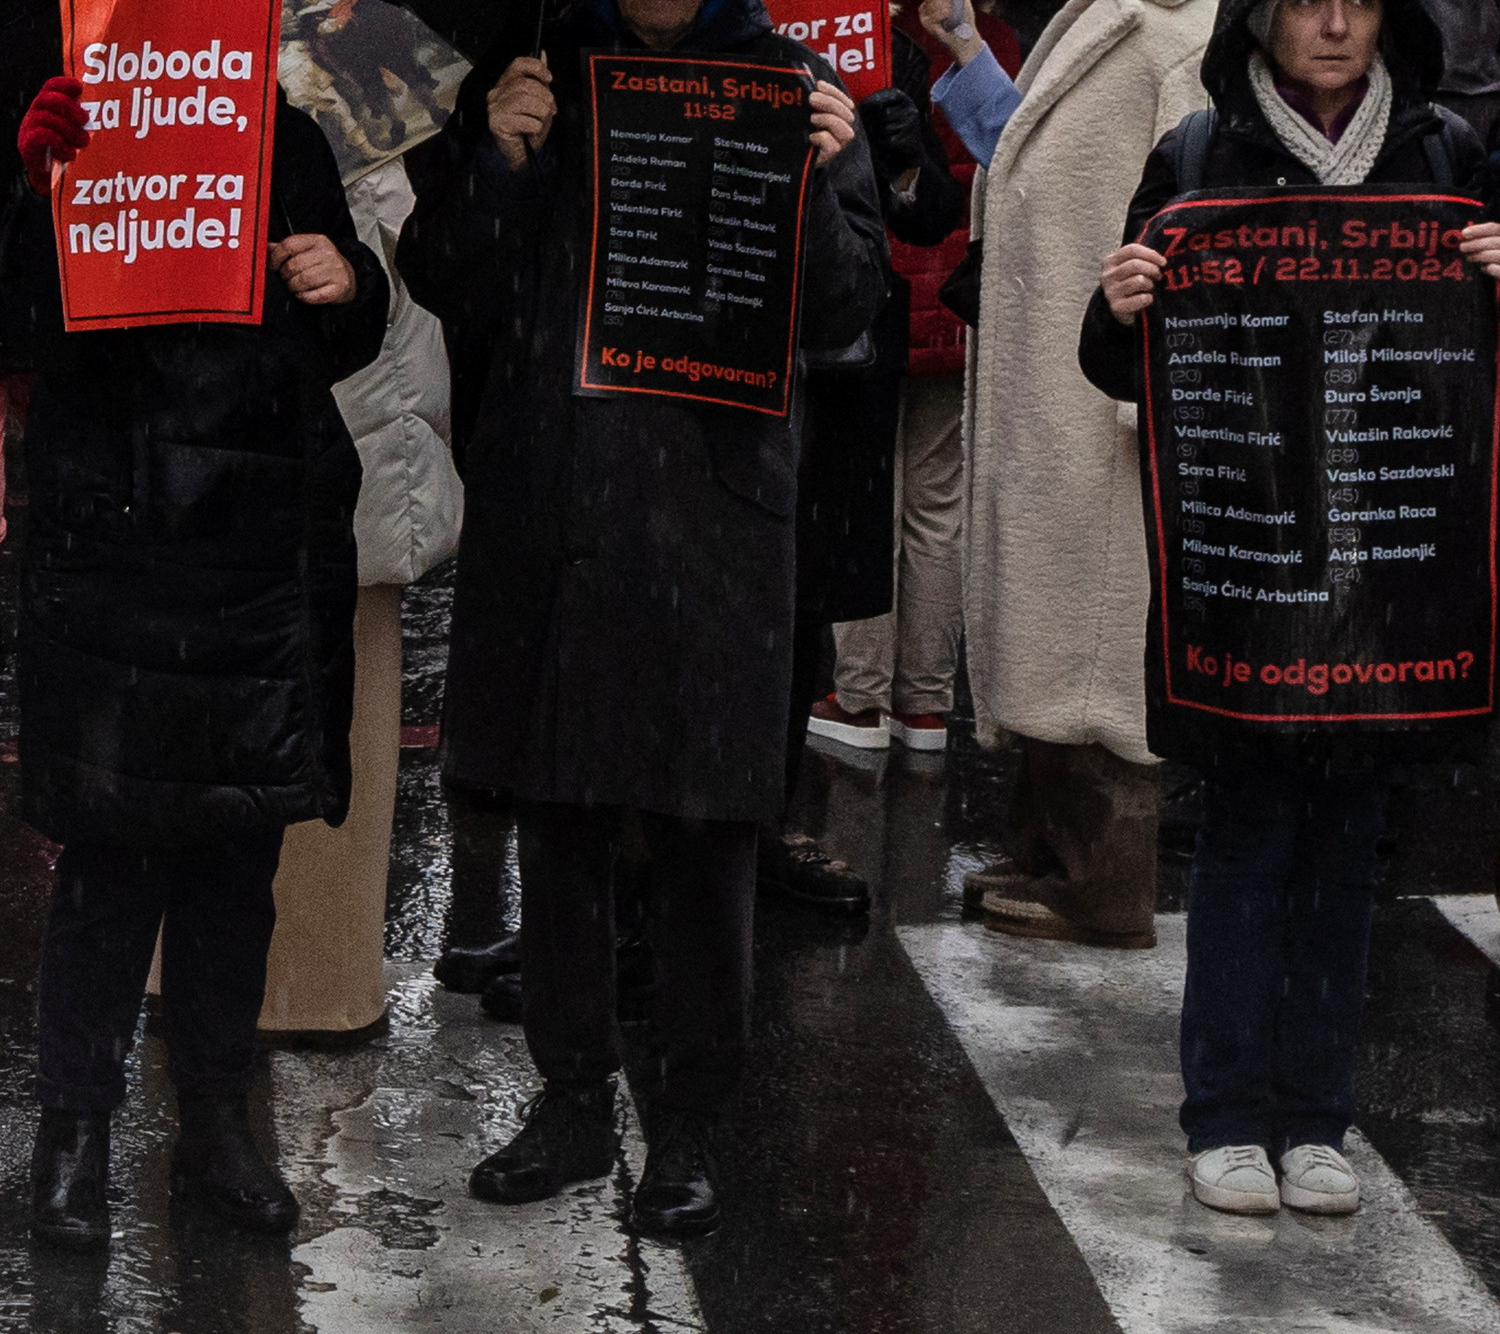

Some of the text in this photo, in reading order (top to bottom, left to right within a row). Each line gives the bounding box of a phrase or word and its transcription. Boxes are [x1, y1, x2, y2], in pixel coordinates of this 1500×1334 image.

[834, 12, 873, 37] za
[82, 39, 252, 85] Sloboda
[611, 71, 803, 108] Zastani, Srbijo!
[80, 85, 248, 139] za ljude,
[683, 103, 735, 121] 11:52
[658, 133, 693, 144] Komar
[650, 156, 687, 168] Ruman
[71, 171, 244, 205] zatvor za
[610, 202, 659, 215] Valentina
[69, 207, 242, 264] neljude!
[609, 227, 634, 237] Sara
[1163, 219, 1473, 257] Zastani, Srbijo
[608, 252, 638, 264] Milica
[1164, 258, 1244, 290] 11:52
[1275, 257, 1473, 281] 22.11.2024.
[606, 277, 640, 290] Mileva
[604, 302, 635, 315] Sanja
[1323, 309, 1424, 324] Stefan Hrka
[1165, 312, 1290, 329] Nemanja Komar
[1166, 333, 1195, 348] (17)
[1323, 329, 1354, 345] (27)
[1230, 352, 1282, 367] Ruman
[1324, 348, 1475, 364] Miloš Milosavljević
[601, 347, 777, 388] Ko je odgovoran?
[1225, 390, 1254, 406] Firić
[1324, 385, 1421, 404] Đuro Švonja
[1324, 409, 1357, 425] (77)
[1174, 425, 1281, 446] Valentina Firić
[1325, 425, 1453, 443] Vukašin Raković
[1178, 463, 1247, 481] Sara Firić
[1326, 464, 1455, 483] Vasko Sazdovski
[1327, 488, 1359, 504] (45)
[1181, 500, 1296, 525] Milica Adamović
[1327, 505, 1436, 522] Goranka Raca
[1182, 538, 1303, 564] Mileva Karanović
[1328, 544, 1436, 564] Anja Radonjić
[1329, 567, 1361, 582] (24)
[1182, 577, 1329, 603] Sanja Ćirić Arbutina
[1186, 644, 1474, 695] Ko je odgovoran?
